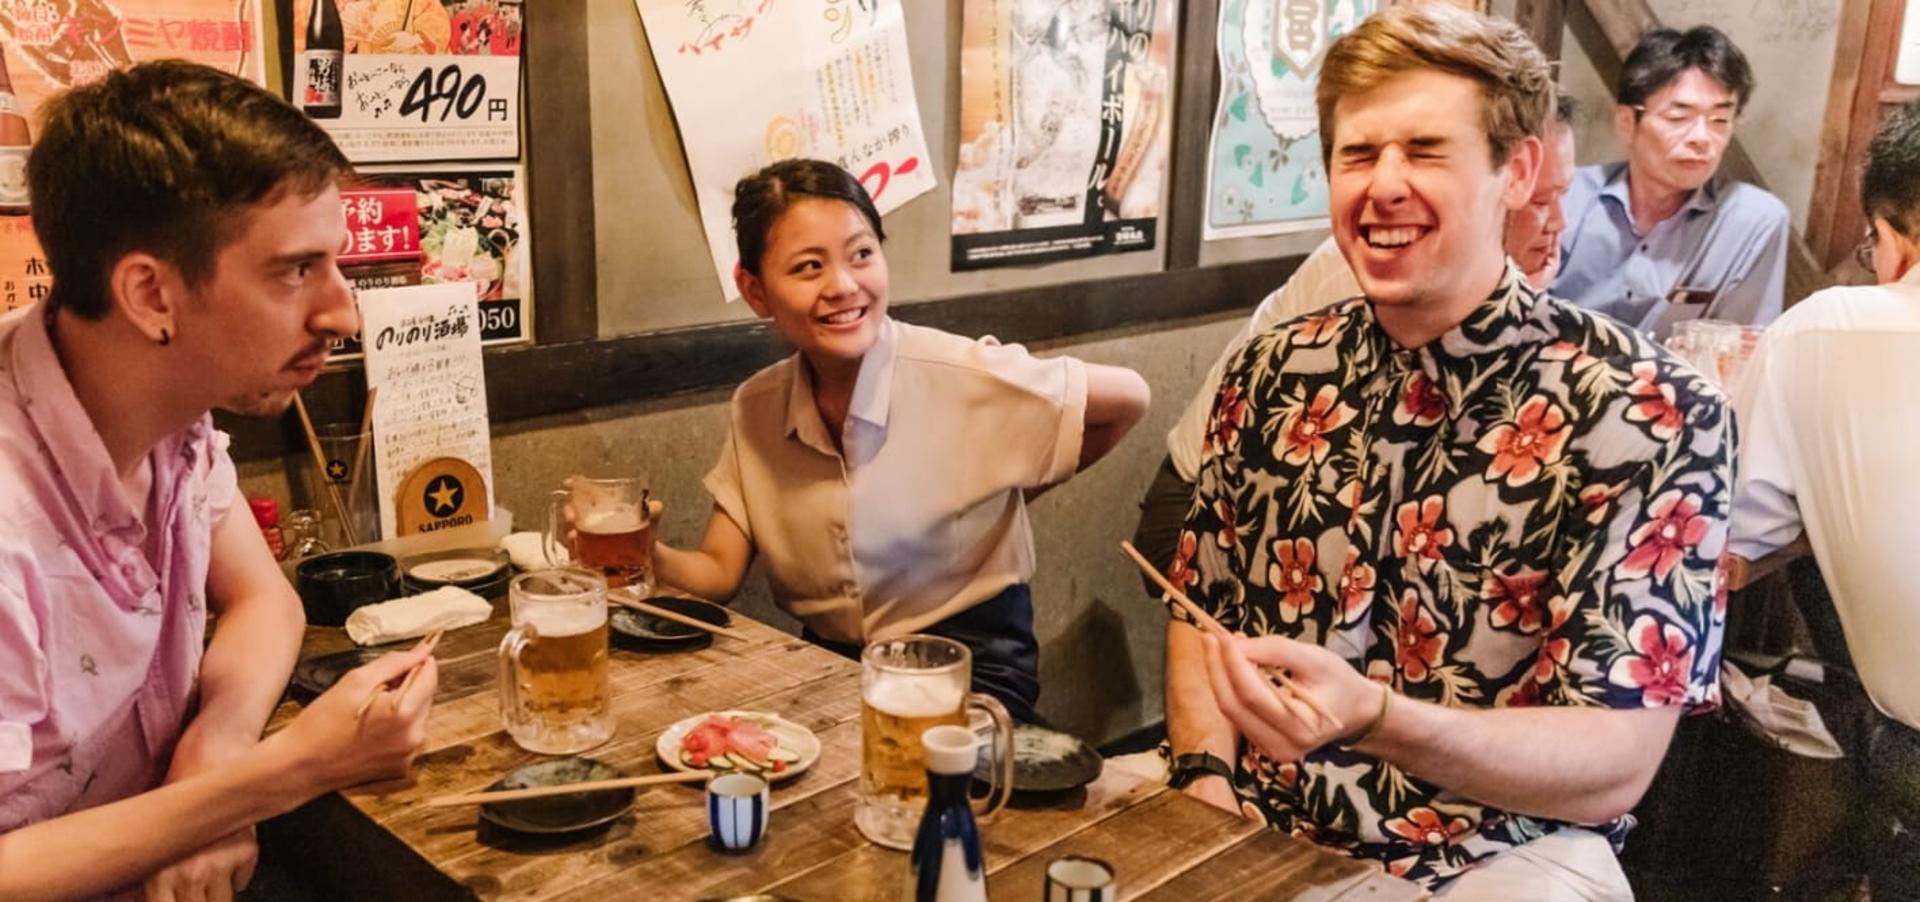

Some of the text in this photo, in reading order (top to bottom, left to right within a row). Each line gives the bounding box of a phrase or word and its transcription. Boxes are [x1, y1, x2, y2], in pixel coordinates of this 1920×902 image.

[398, 64, 508, 123] 490 円
[376, 315, 470, 352] のりのり酒場
[418, 514, 473, 533] SAPPORO
